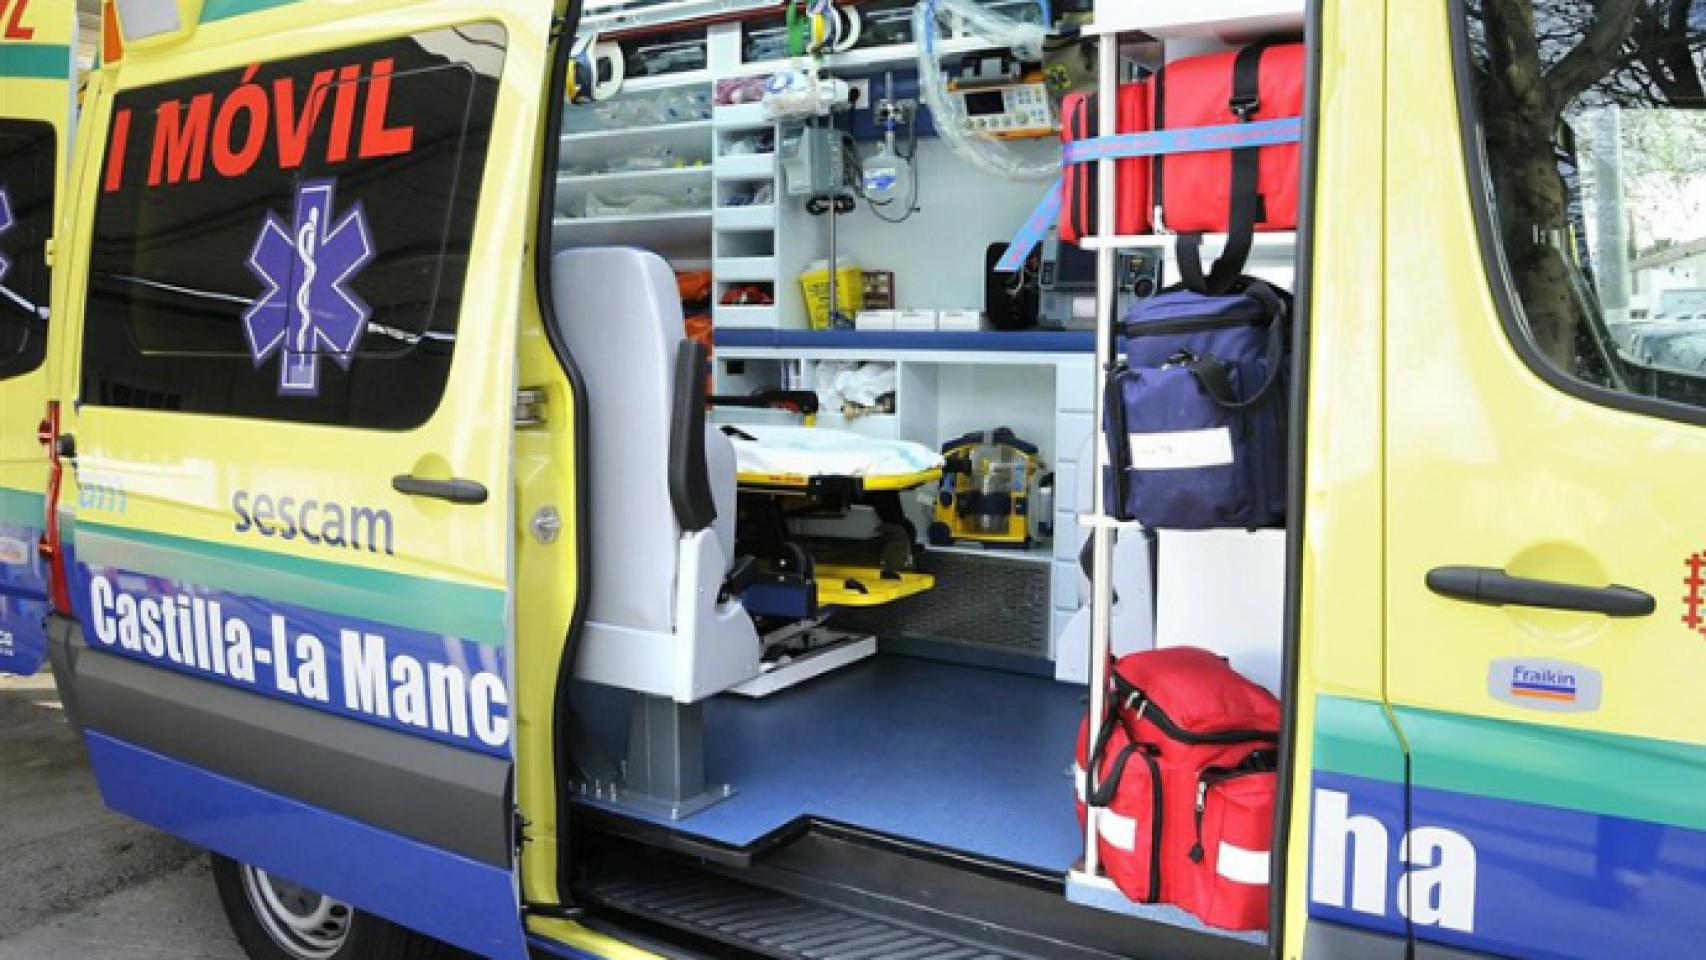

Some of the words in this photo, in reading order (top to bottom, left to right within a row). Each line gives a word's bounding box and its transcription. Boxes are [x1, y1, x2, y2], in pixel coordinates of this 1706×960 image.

[104, 109, 132, 192] I
[148, 61, 414, 187] MÓVIL
[232, 488, 394, 555] sescam
[91, 576, 329, 701] Castilla-La
[340, 628, 510, 746] Manc
[1512, 665, 1576, 687] Fraikin
[1312, 788, 1477, 933] ha
